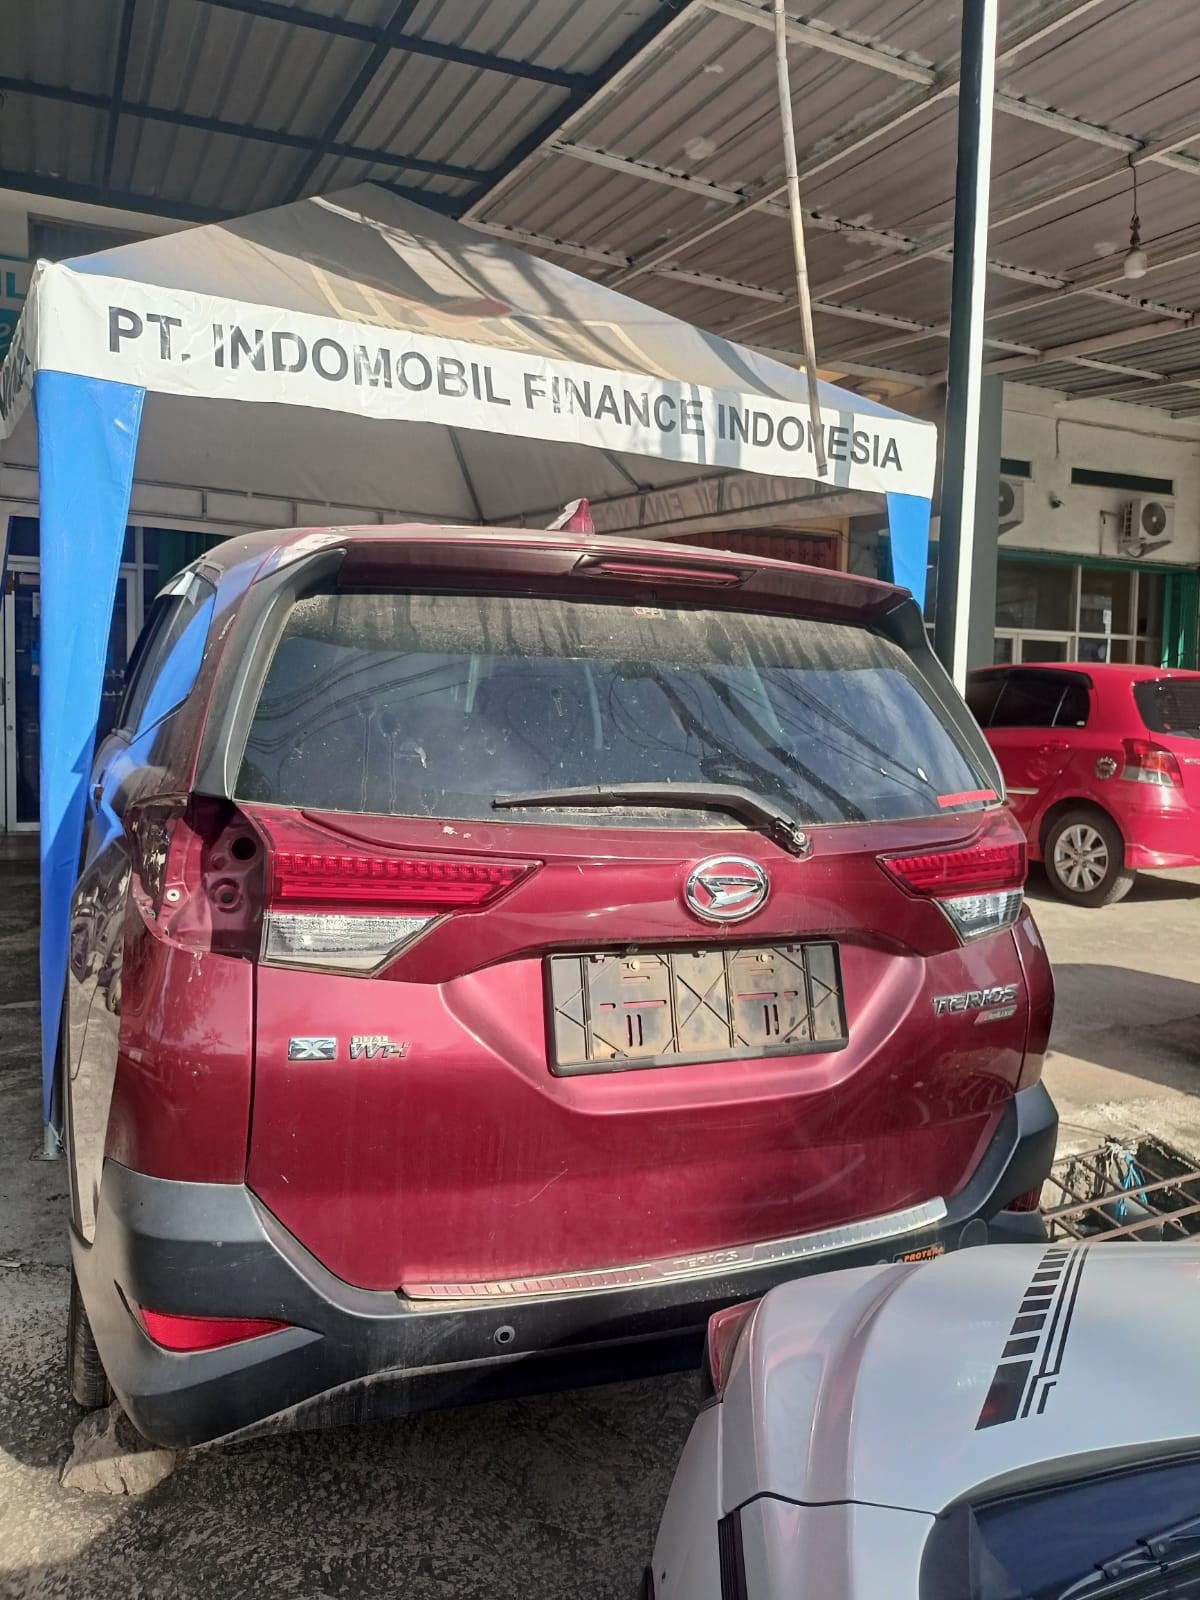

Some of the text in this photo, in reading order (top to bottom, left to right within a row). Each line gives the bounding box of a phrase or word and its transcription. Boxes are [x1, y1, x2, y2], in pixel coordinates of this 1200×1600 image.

[108, 306, 191, 362] PT.
[212, 323, 512, 407] INDOMOBIL
[523, 372, 705, 437] FINANCE
[932, 983, 1018, 1015] TERIOS
